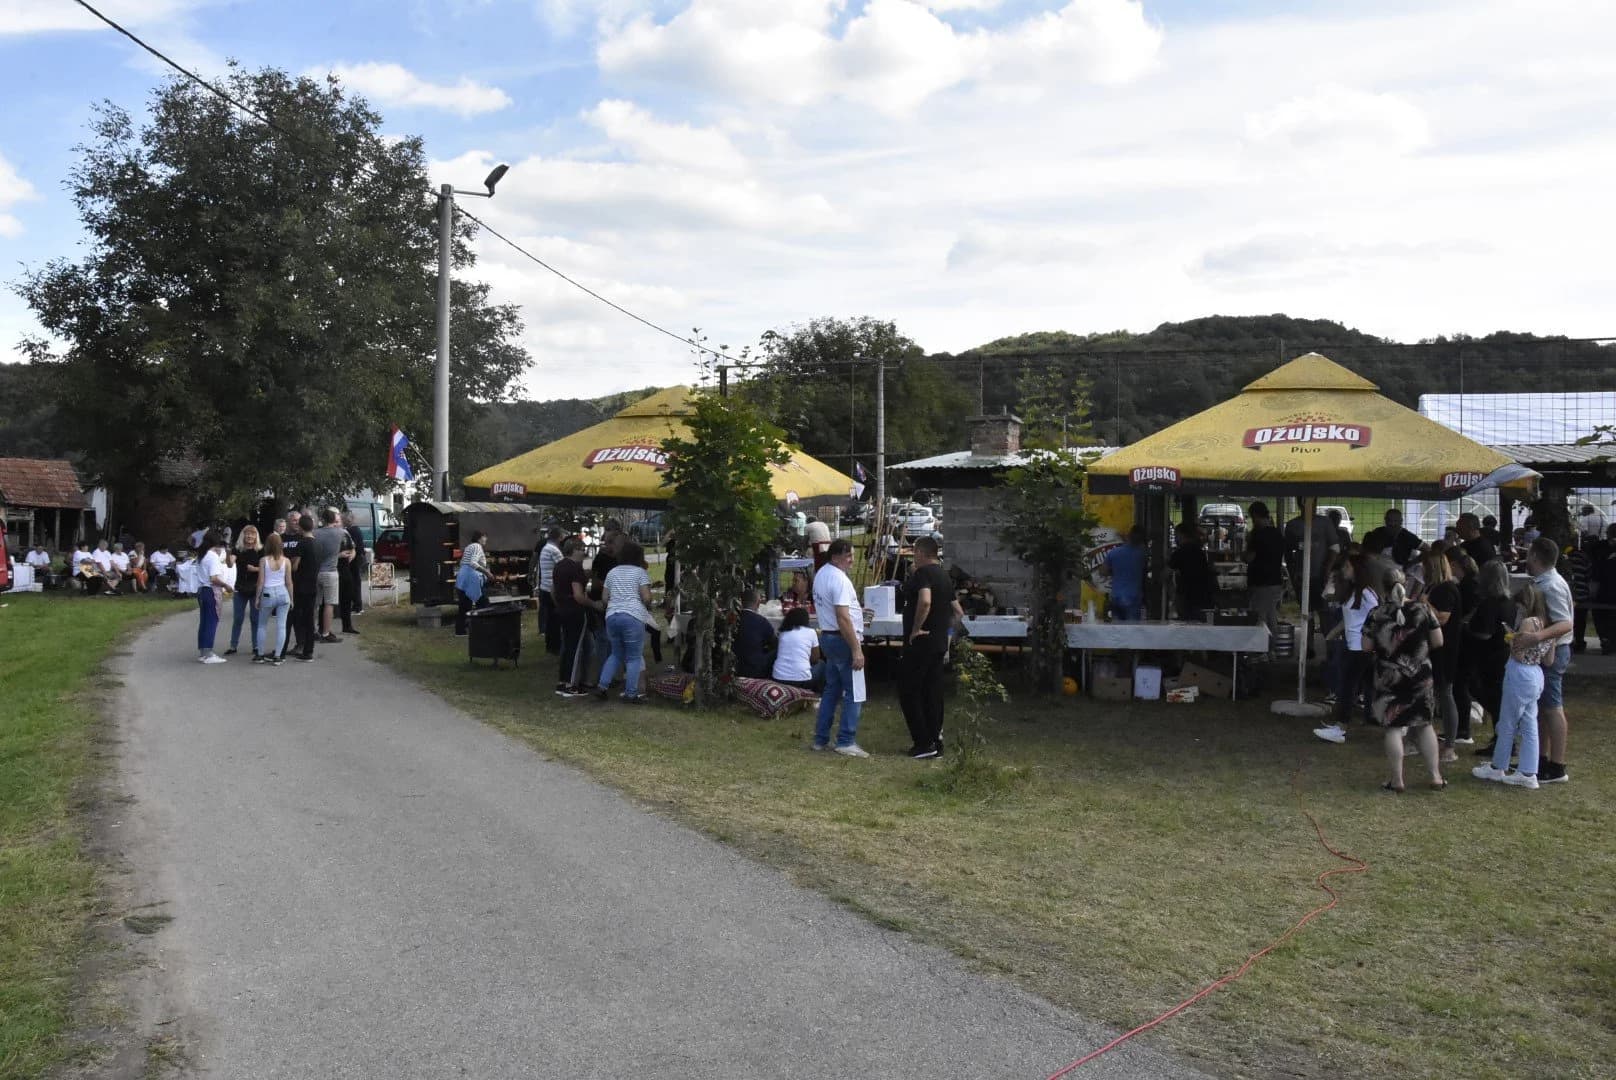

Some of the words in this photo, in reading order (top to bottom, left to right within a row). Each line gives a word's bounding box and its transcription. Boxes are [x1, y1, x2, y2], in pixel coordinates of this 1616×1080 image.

[1254, 424, 1360, 444] Ožujsko
[1133, 466, 1177, 482] Ožujsko
[1444, 472, 1484, 488] Ožujs
